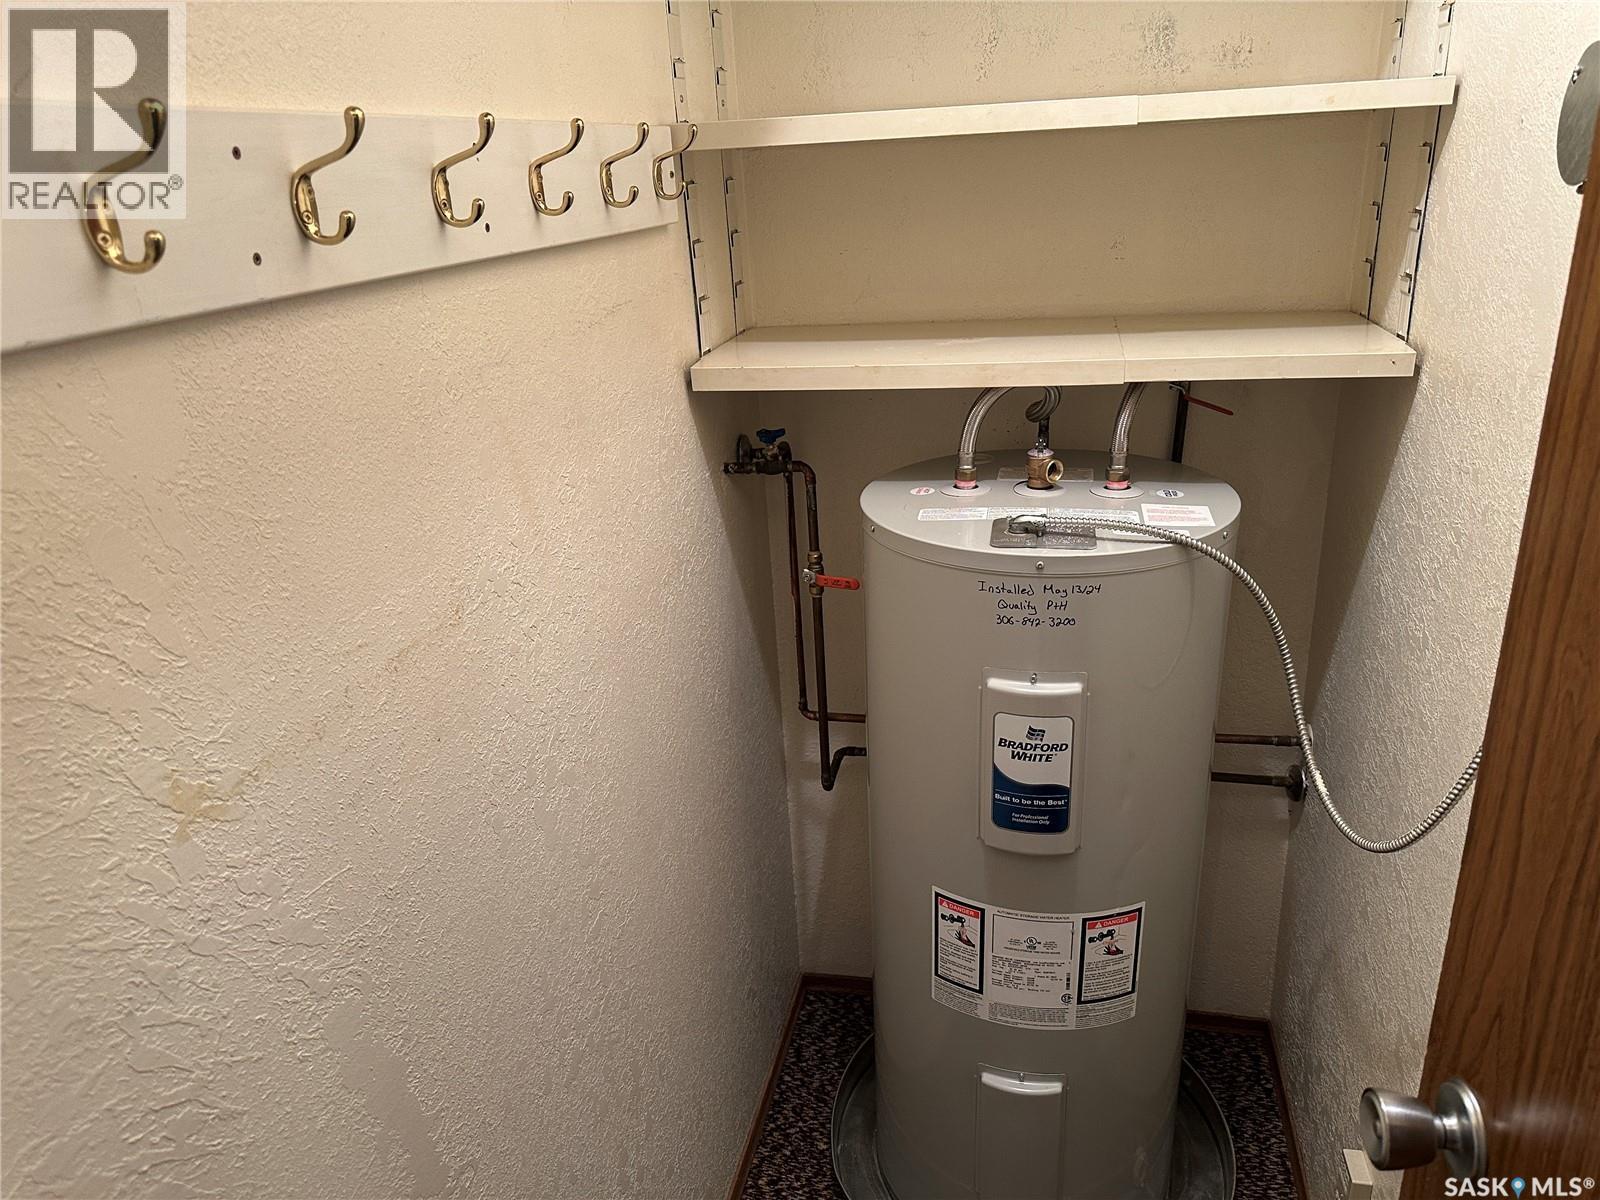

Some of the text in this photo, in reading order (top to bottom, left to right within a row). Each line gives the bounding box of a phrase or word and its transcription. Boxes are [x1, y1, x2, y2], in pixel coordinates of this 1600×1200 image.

[977, 580, 1102, 598] Installed May 13/24
[997, 599, 1037, 615] Quality
[996, 613, 1076, 627] 306-842-3200
[997, 737, 1069, 752] BRADFORD
[1010, 751, 1053, 763] WHITE
[994, 793, 1011, 802] Built
[949, 901, 975, 917] DANGER
[1103, 916, 1129, 927] DANGER
